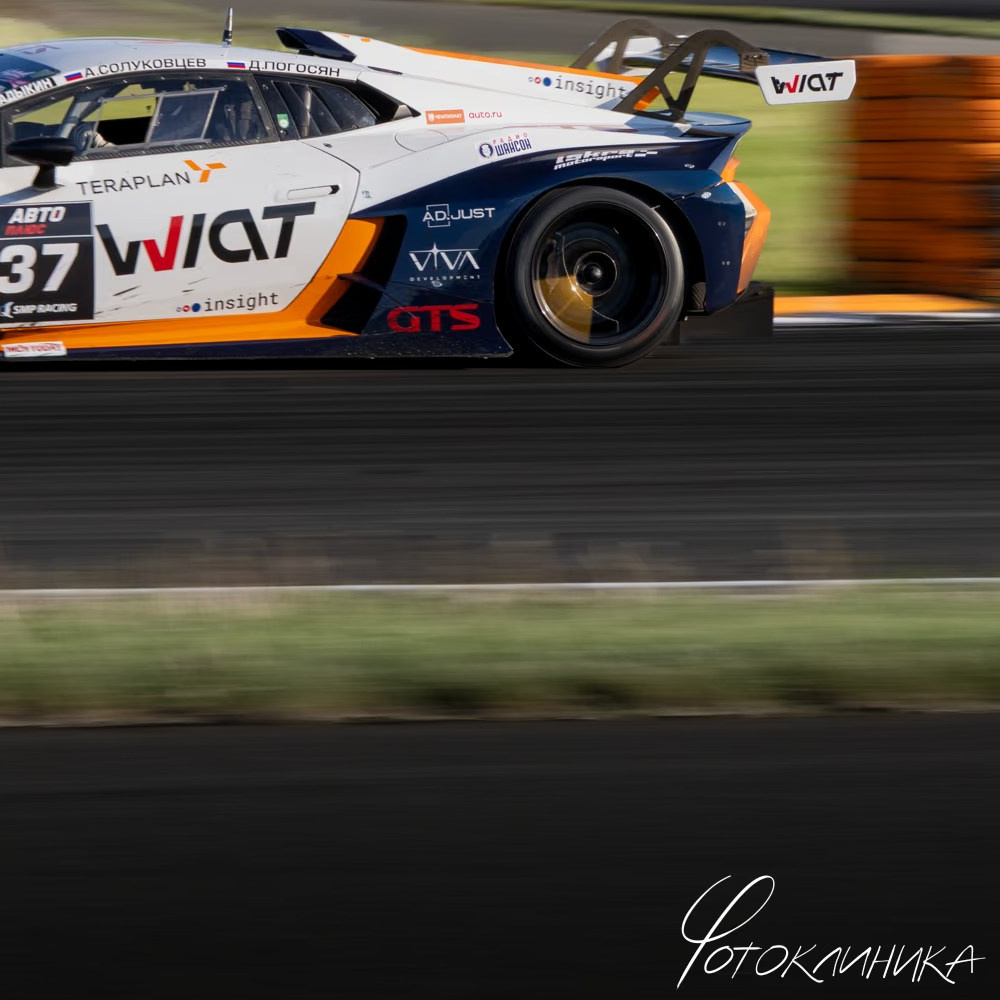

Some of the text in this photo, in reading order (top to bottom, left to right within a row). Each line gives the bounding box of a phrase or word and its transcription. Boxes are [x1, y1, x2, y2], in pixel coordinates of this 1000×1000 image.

[84, 58, 207, 78] А.СОЛУКОВЦЕВ
[249, 60, 340, 77] Д.ПОГОСЯН
[555, 75, 628, 100] insight
[468, 111, 503, 119] auto.ru
[492, 132, 528, 145] РАДИО
[494, 138, 532, 157] ШАНСОН
[76, 171, 192, 196] TERAPLAN
[7, 206, 67, 225] АВТО
[409, 243, 480, 271] VIVA
[12, 303, 78, 315] SMP RACING
[204, 292, 279, 313] insight
[387, 303, 481, 333] GTS
